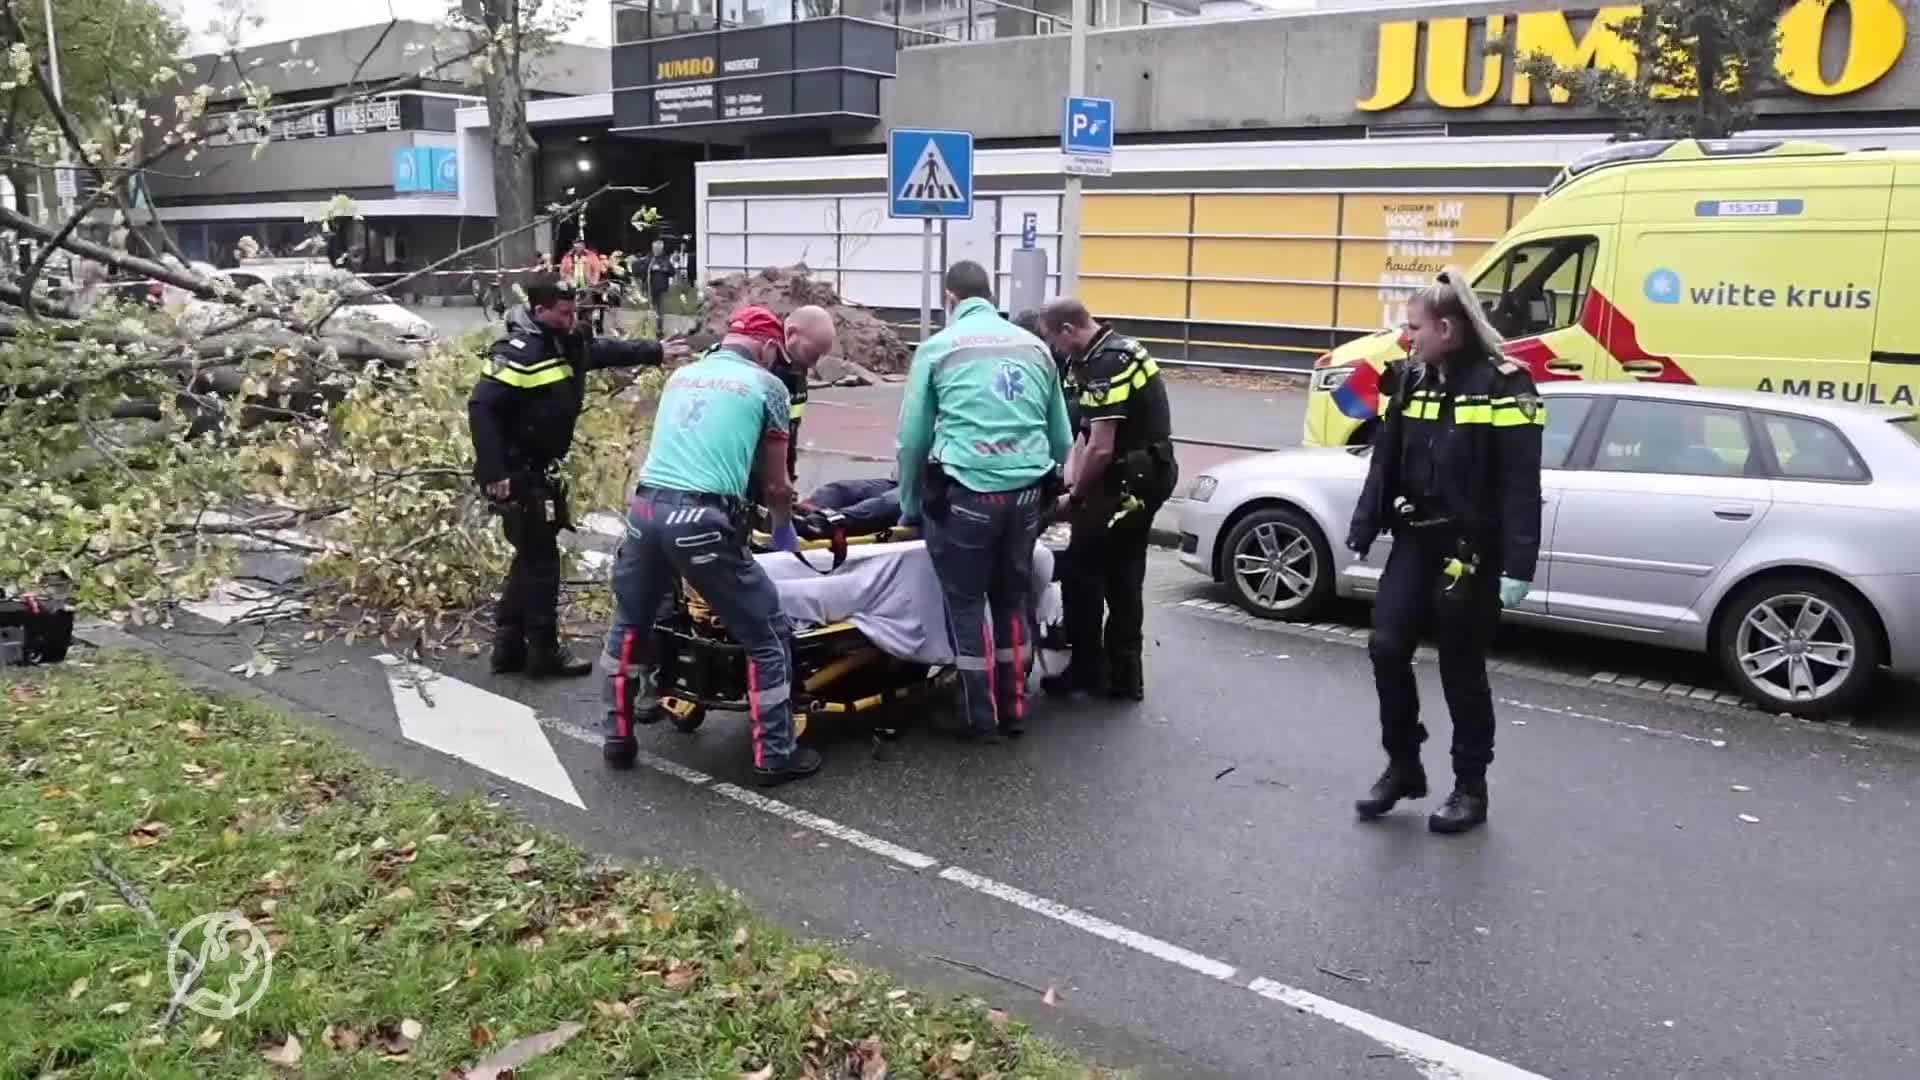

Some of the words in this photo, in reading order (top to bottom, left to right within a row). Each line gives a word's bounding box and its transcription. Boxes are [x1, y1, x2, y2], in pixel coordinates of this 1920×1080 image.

[1355, 0, 1907, 111] JUMO
[656, 56, 714, 80] JUMBO
[1072, 113, 1088, 137] P
[1385, 256, 1432, 273] houden
[1690, 281, 1777, 308] witte
[1787, 283, 1872, 309] kruis
